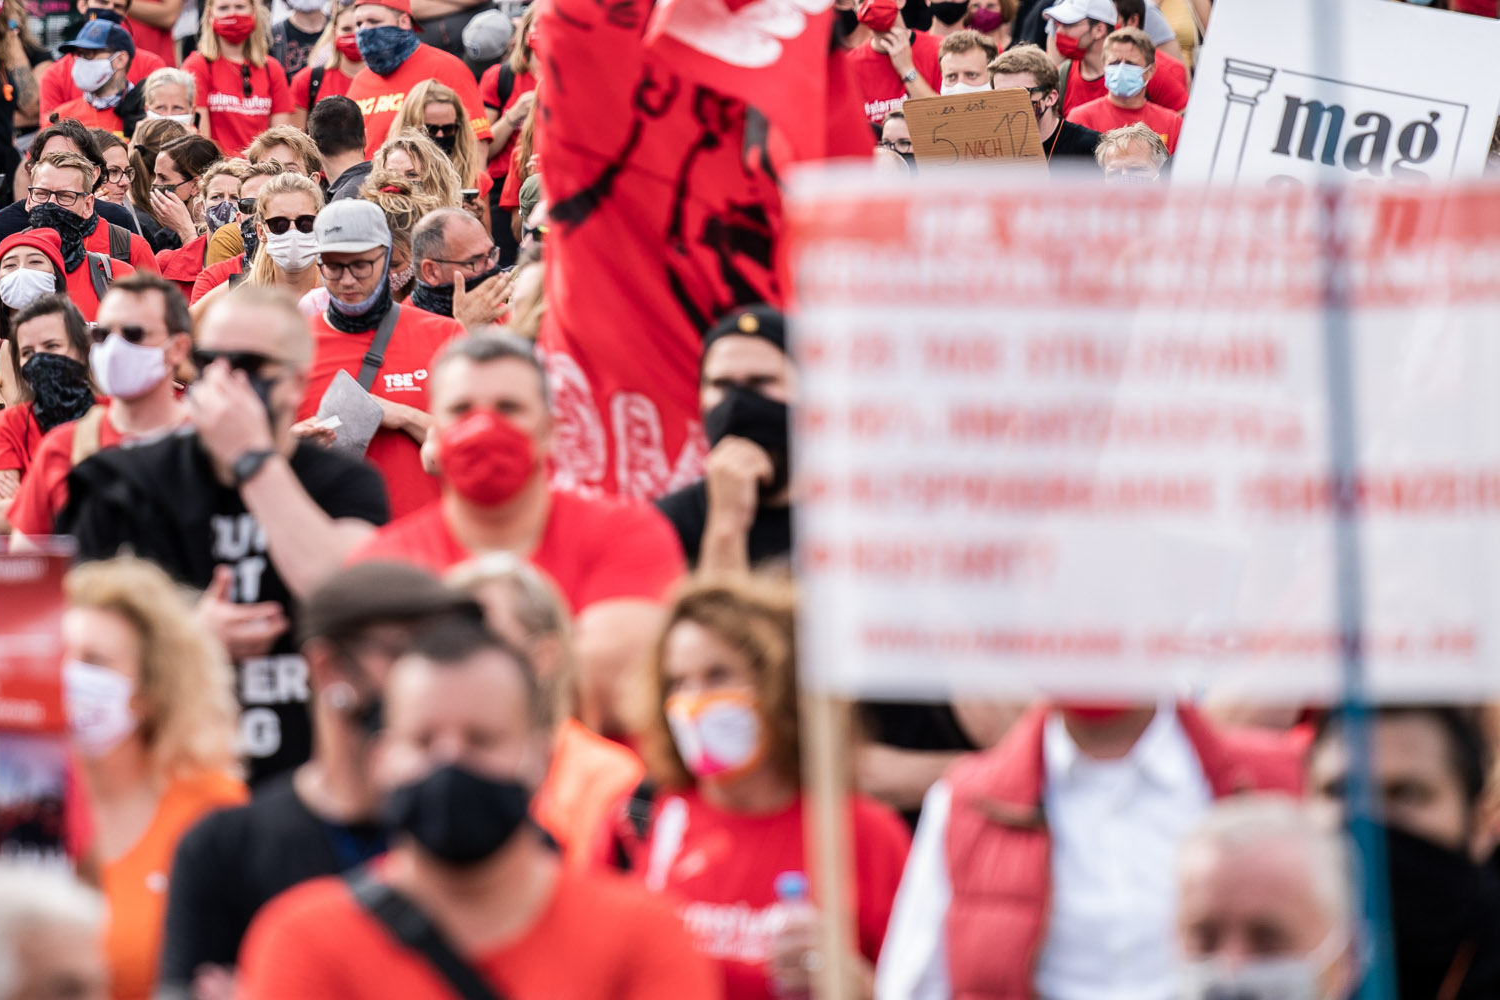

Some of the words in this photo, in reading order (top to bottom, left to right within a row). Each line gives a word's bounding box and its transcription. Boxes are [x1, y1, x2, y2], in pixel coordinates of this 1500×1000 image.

[932, 121, 960, 167] 5
[964, 139, 1003, 161] NACH
[993, 110, 1039, 159] 12
[1271, 94, 1441, 178] mag
[383, 372, 414, 388] TSE
